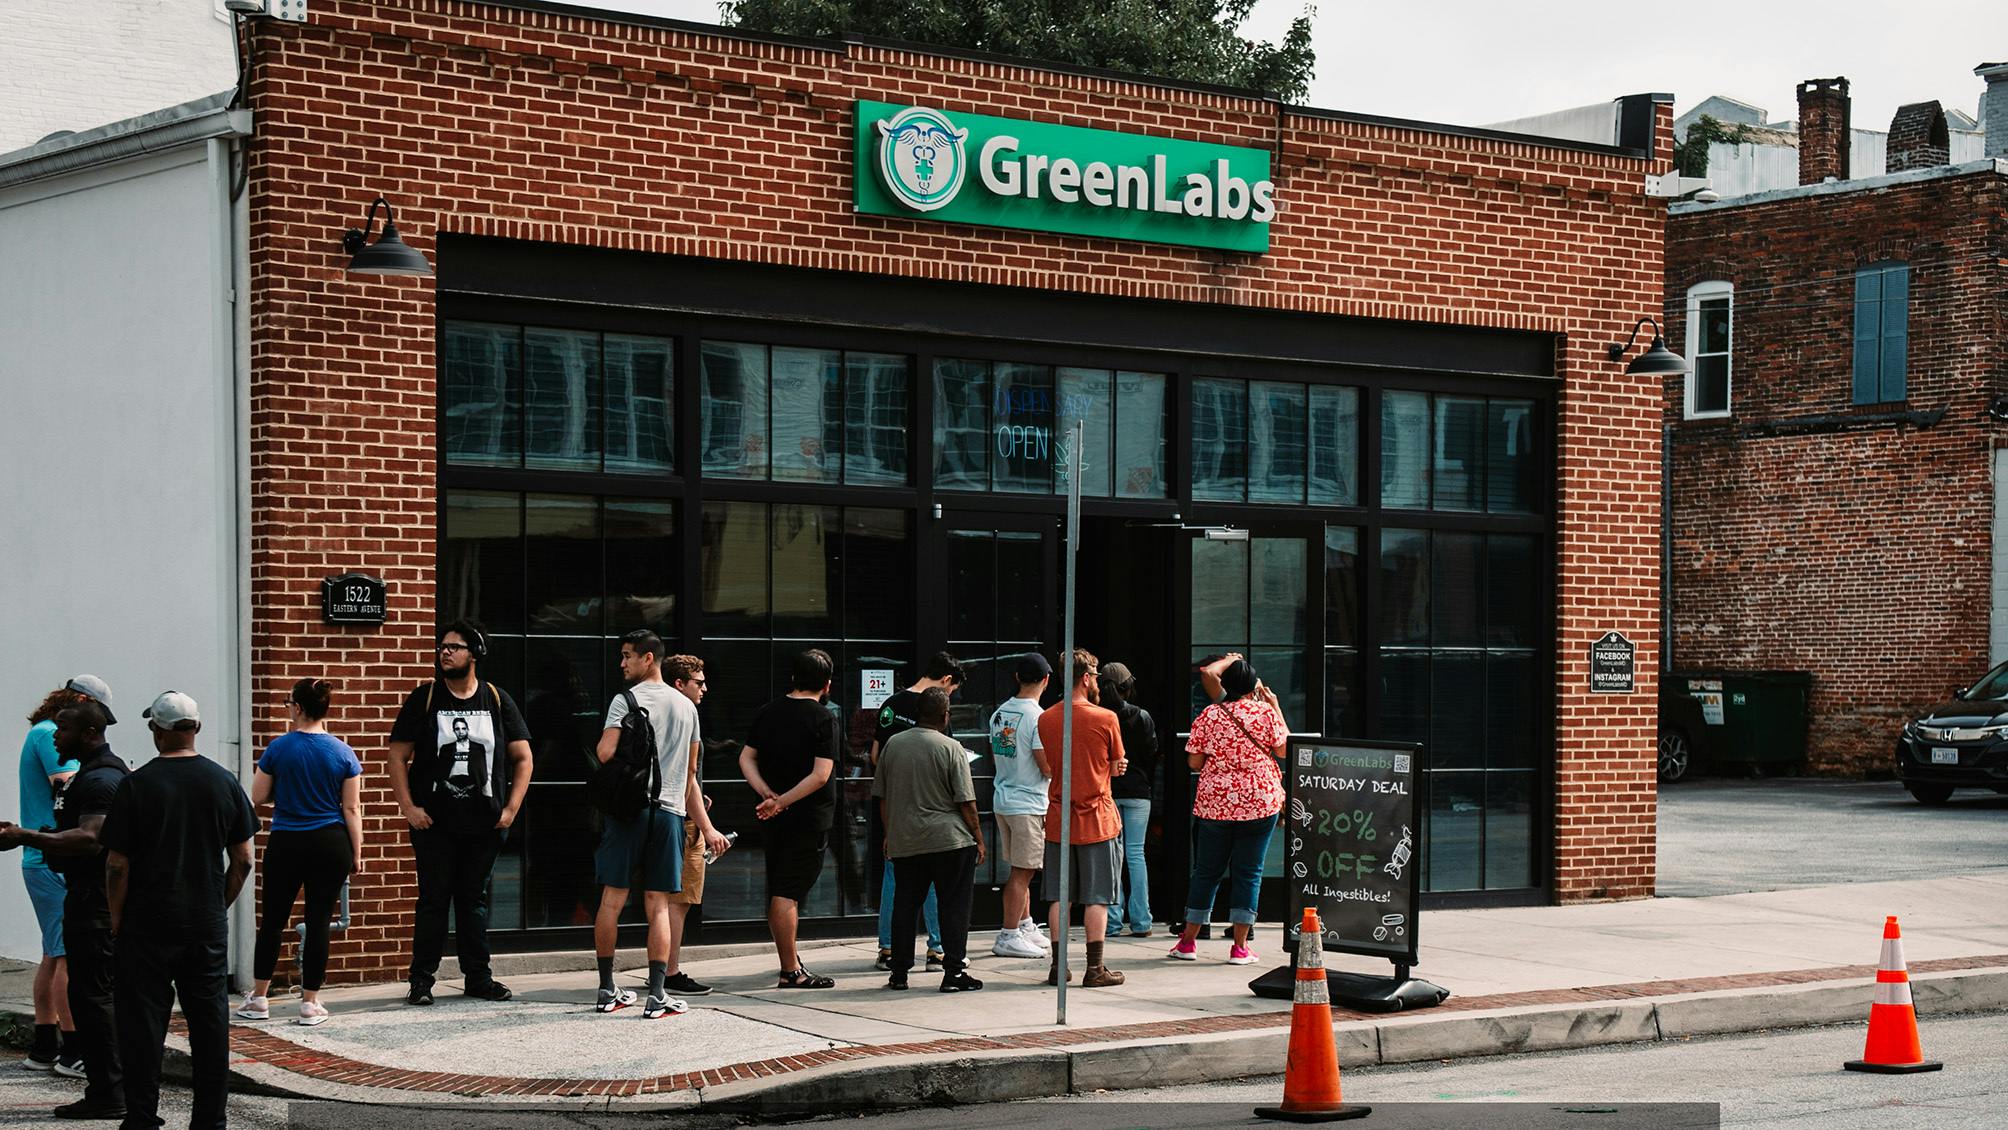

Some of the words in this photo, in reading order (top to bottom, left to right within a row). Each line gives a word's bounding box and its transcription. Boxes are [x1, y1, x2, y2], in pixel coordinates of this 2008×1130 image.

[979, 135, 1275, 223] GreenLabs
[998, 425, 1048, 460] OPEN
[345, 585, 370, 602] 1522
[1596, 652, 1630, 660] FACEBOOK
[869, 679, 886, 689] 21+
[1595, 673, 1631, 681] INSTAGRAM
[1330, 753, 1393, 769] GreenLabs
[1299, 774, 1367, 792] SATURDAY
[1371, 780, 1408, 795] DEAL
[1318, 809, 1376, 840] 20%
[1317, 851, 1376, 880] OFF
[1302, 884, 1319, 895] All
[1323, 886, 1391, 903] Ingestibles!
